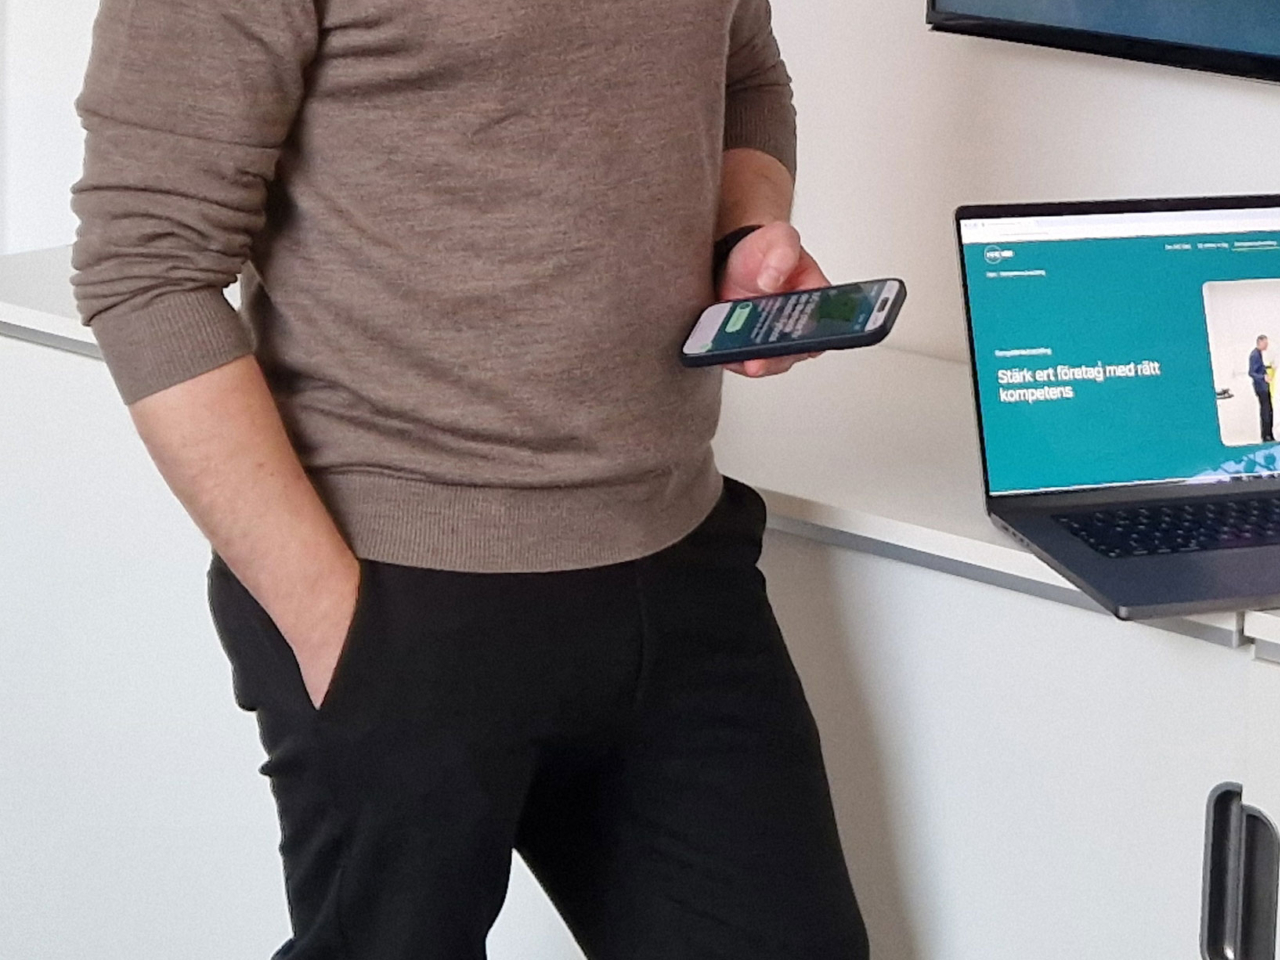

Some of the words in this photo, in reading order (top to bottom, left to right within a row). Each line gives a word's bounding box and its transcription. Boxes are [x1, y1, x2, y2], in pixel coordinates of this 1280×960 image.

[998, 368, 1034, 384] Stärk
[1035, 367, 1055, 382] ert
[1106, 362, 1135, 376] med
[1138, 360, 1160, 375] rätt
[1000, 386, 1074, 404] kompetens
